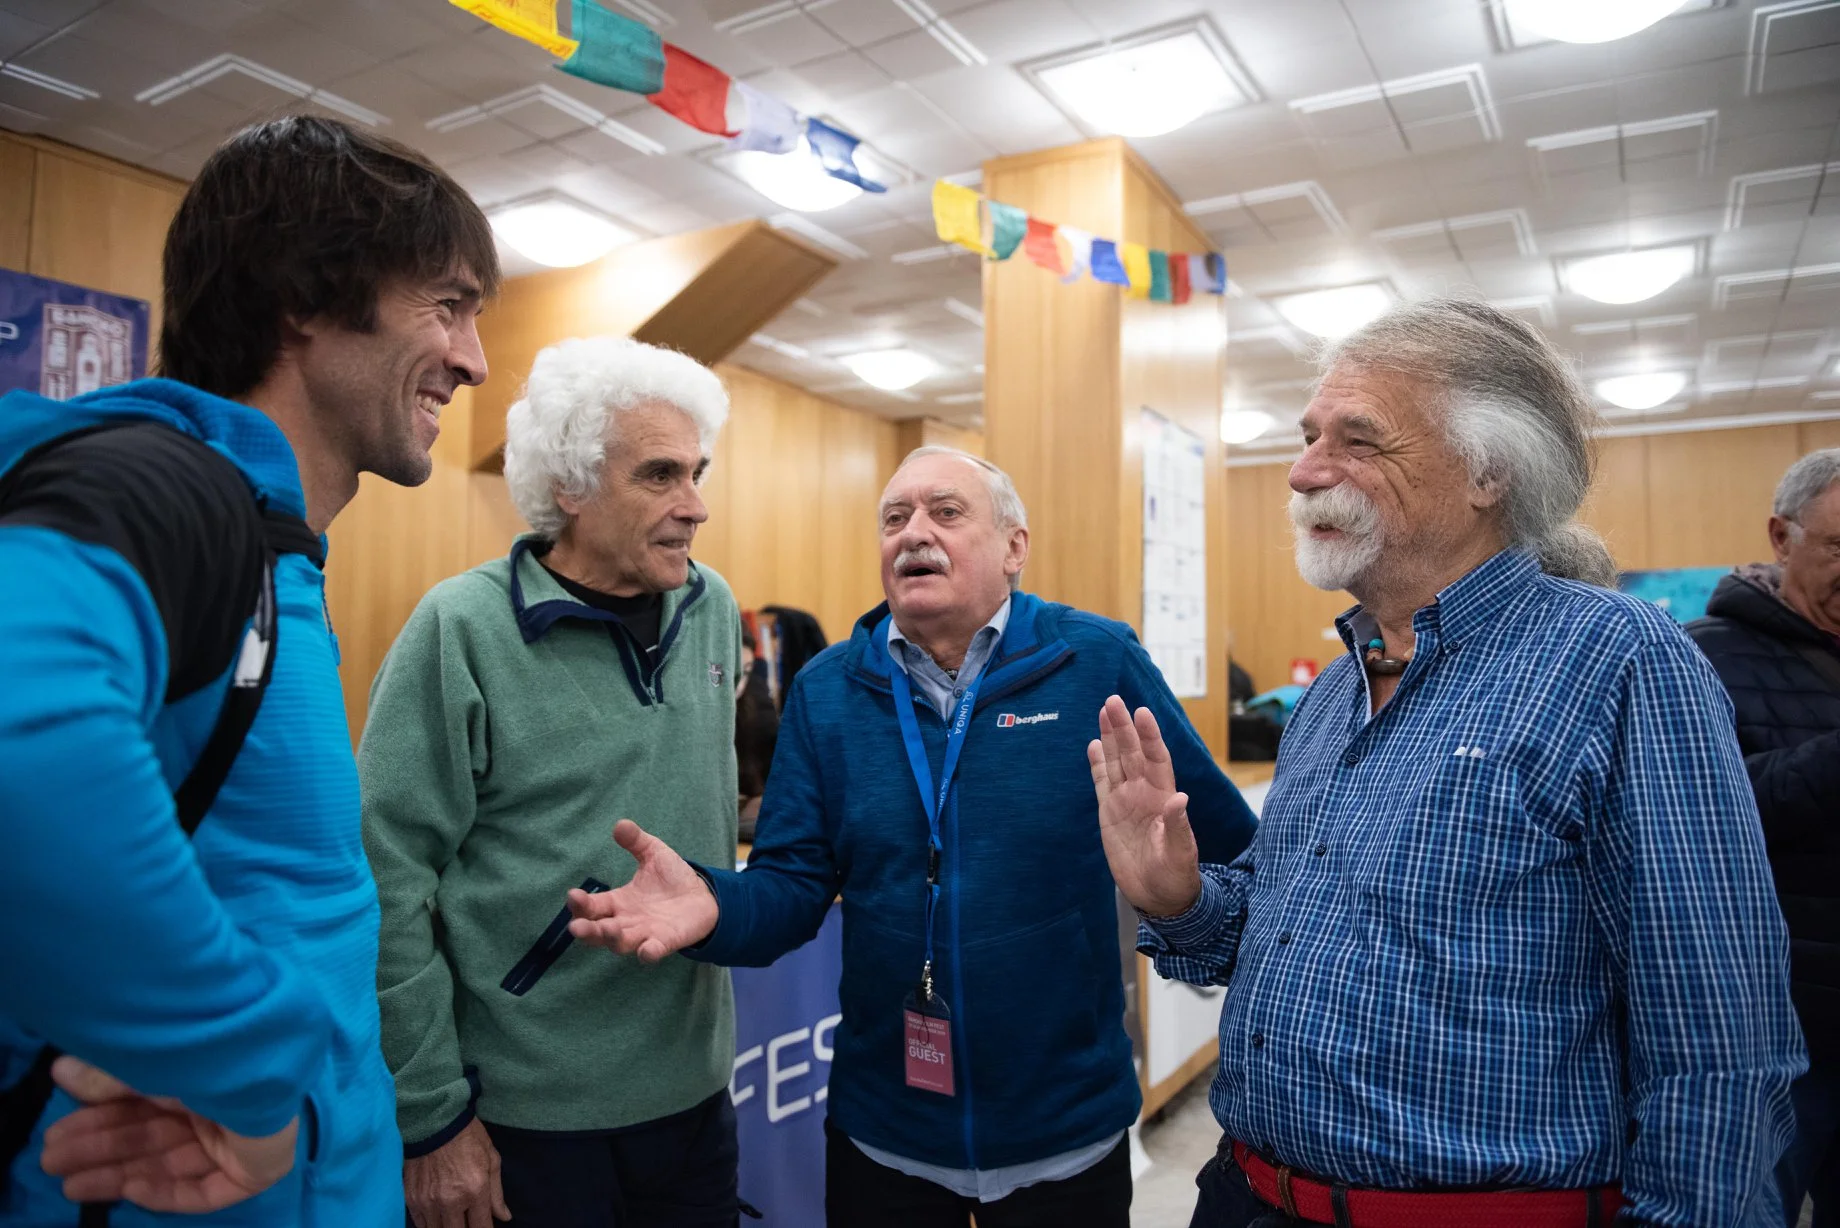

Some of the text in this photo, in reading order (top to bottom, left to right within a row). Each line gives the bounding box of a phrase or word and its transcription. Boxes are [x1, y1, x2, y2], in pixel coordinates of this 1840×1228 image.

[953, 704, 970, 735] UNIQA
[1015, 712, 1059, 725] berghaus
[908, 1045, 946, 1065] GUEST
